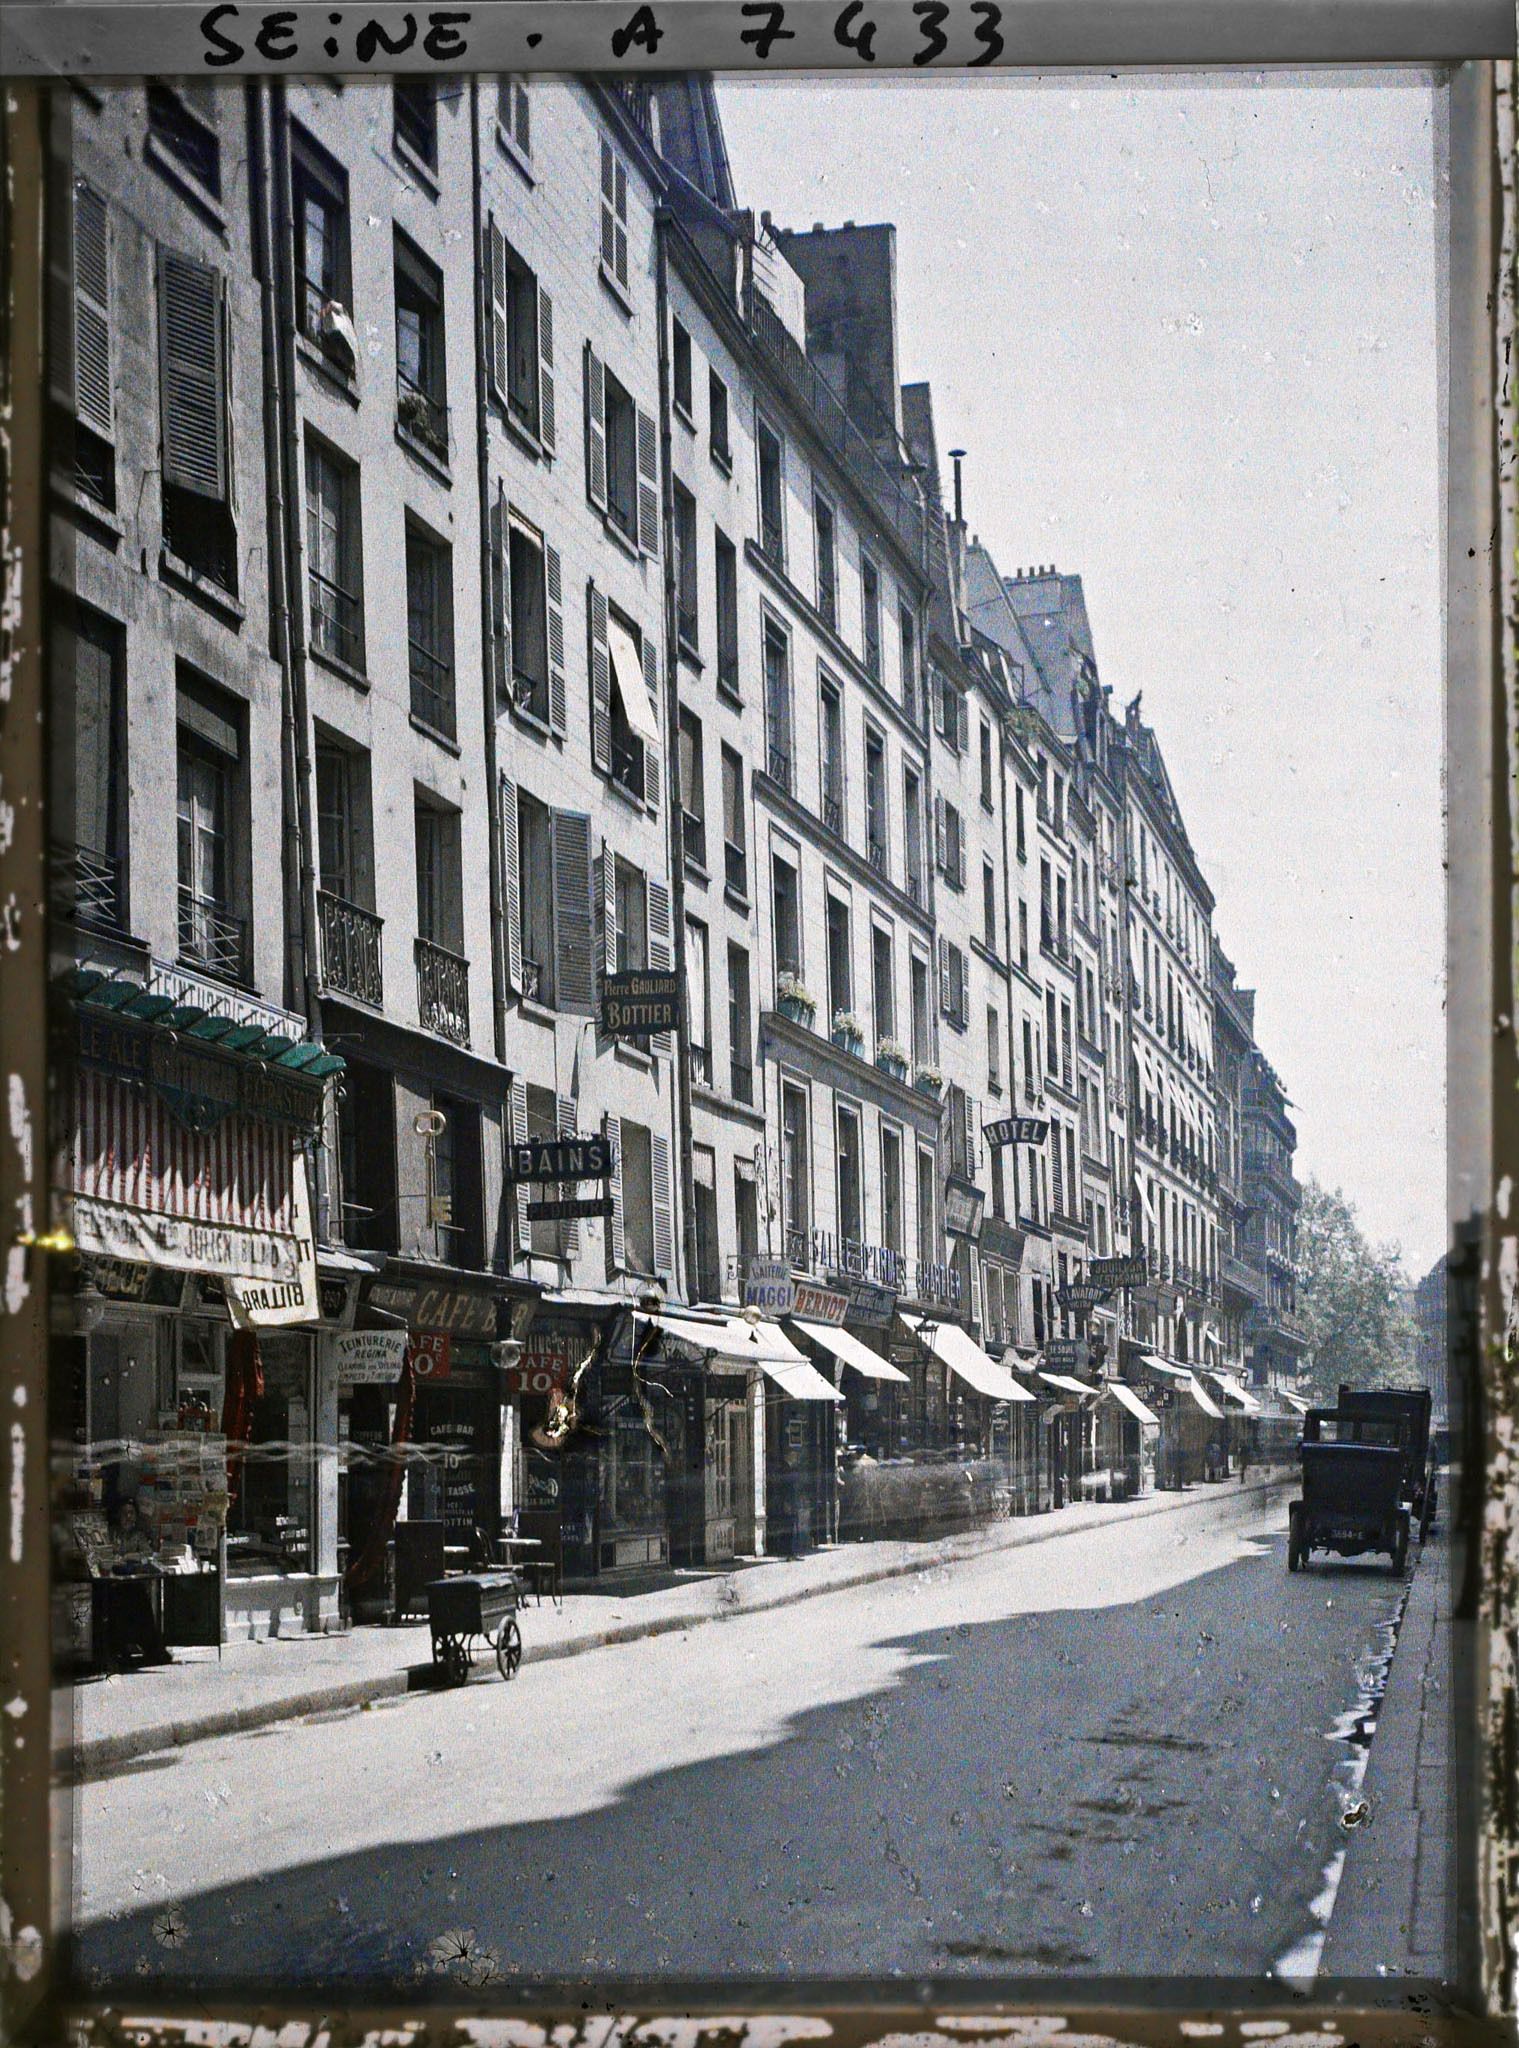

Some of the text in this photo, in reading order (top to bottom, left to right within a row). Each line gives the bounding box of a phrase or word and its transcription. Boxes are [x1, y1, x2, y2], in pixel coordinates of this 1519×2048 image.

[200, 8, 470, 63] SEINE
[612, 7, 664, 55] A
[607, 1002, 672, 1029] BOTTIER
[986, 1121, 1041, 1144] HOTEL
[518, 1147, 602, 1175] BAINS
[747, 1286, 792, 1307] MAGGI
[481, 1300, 528, 1336] BR
[339, 1335, 402, 1354] TEINTURERIE
[354, 1348, 387, 1359] REGINA
